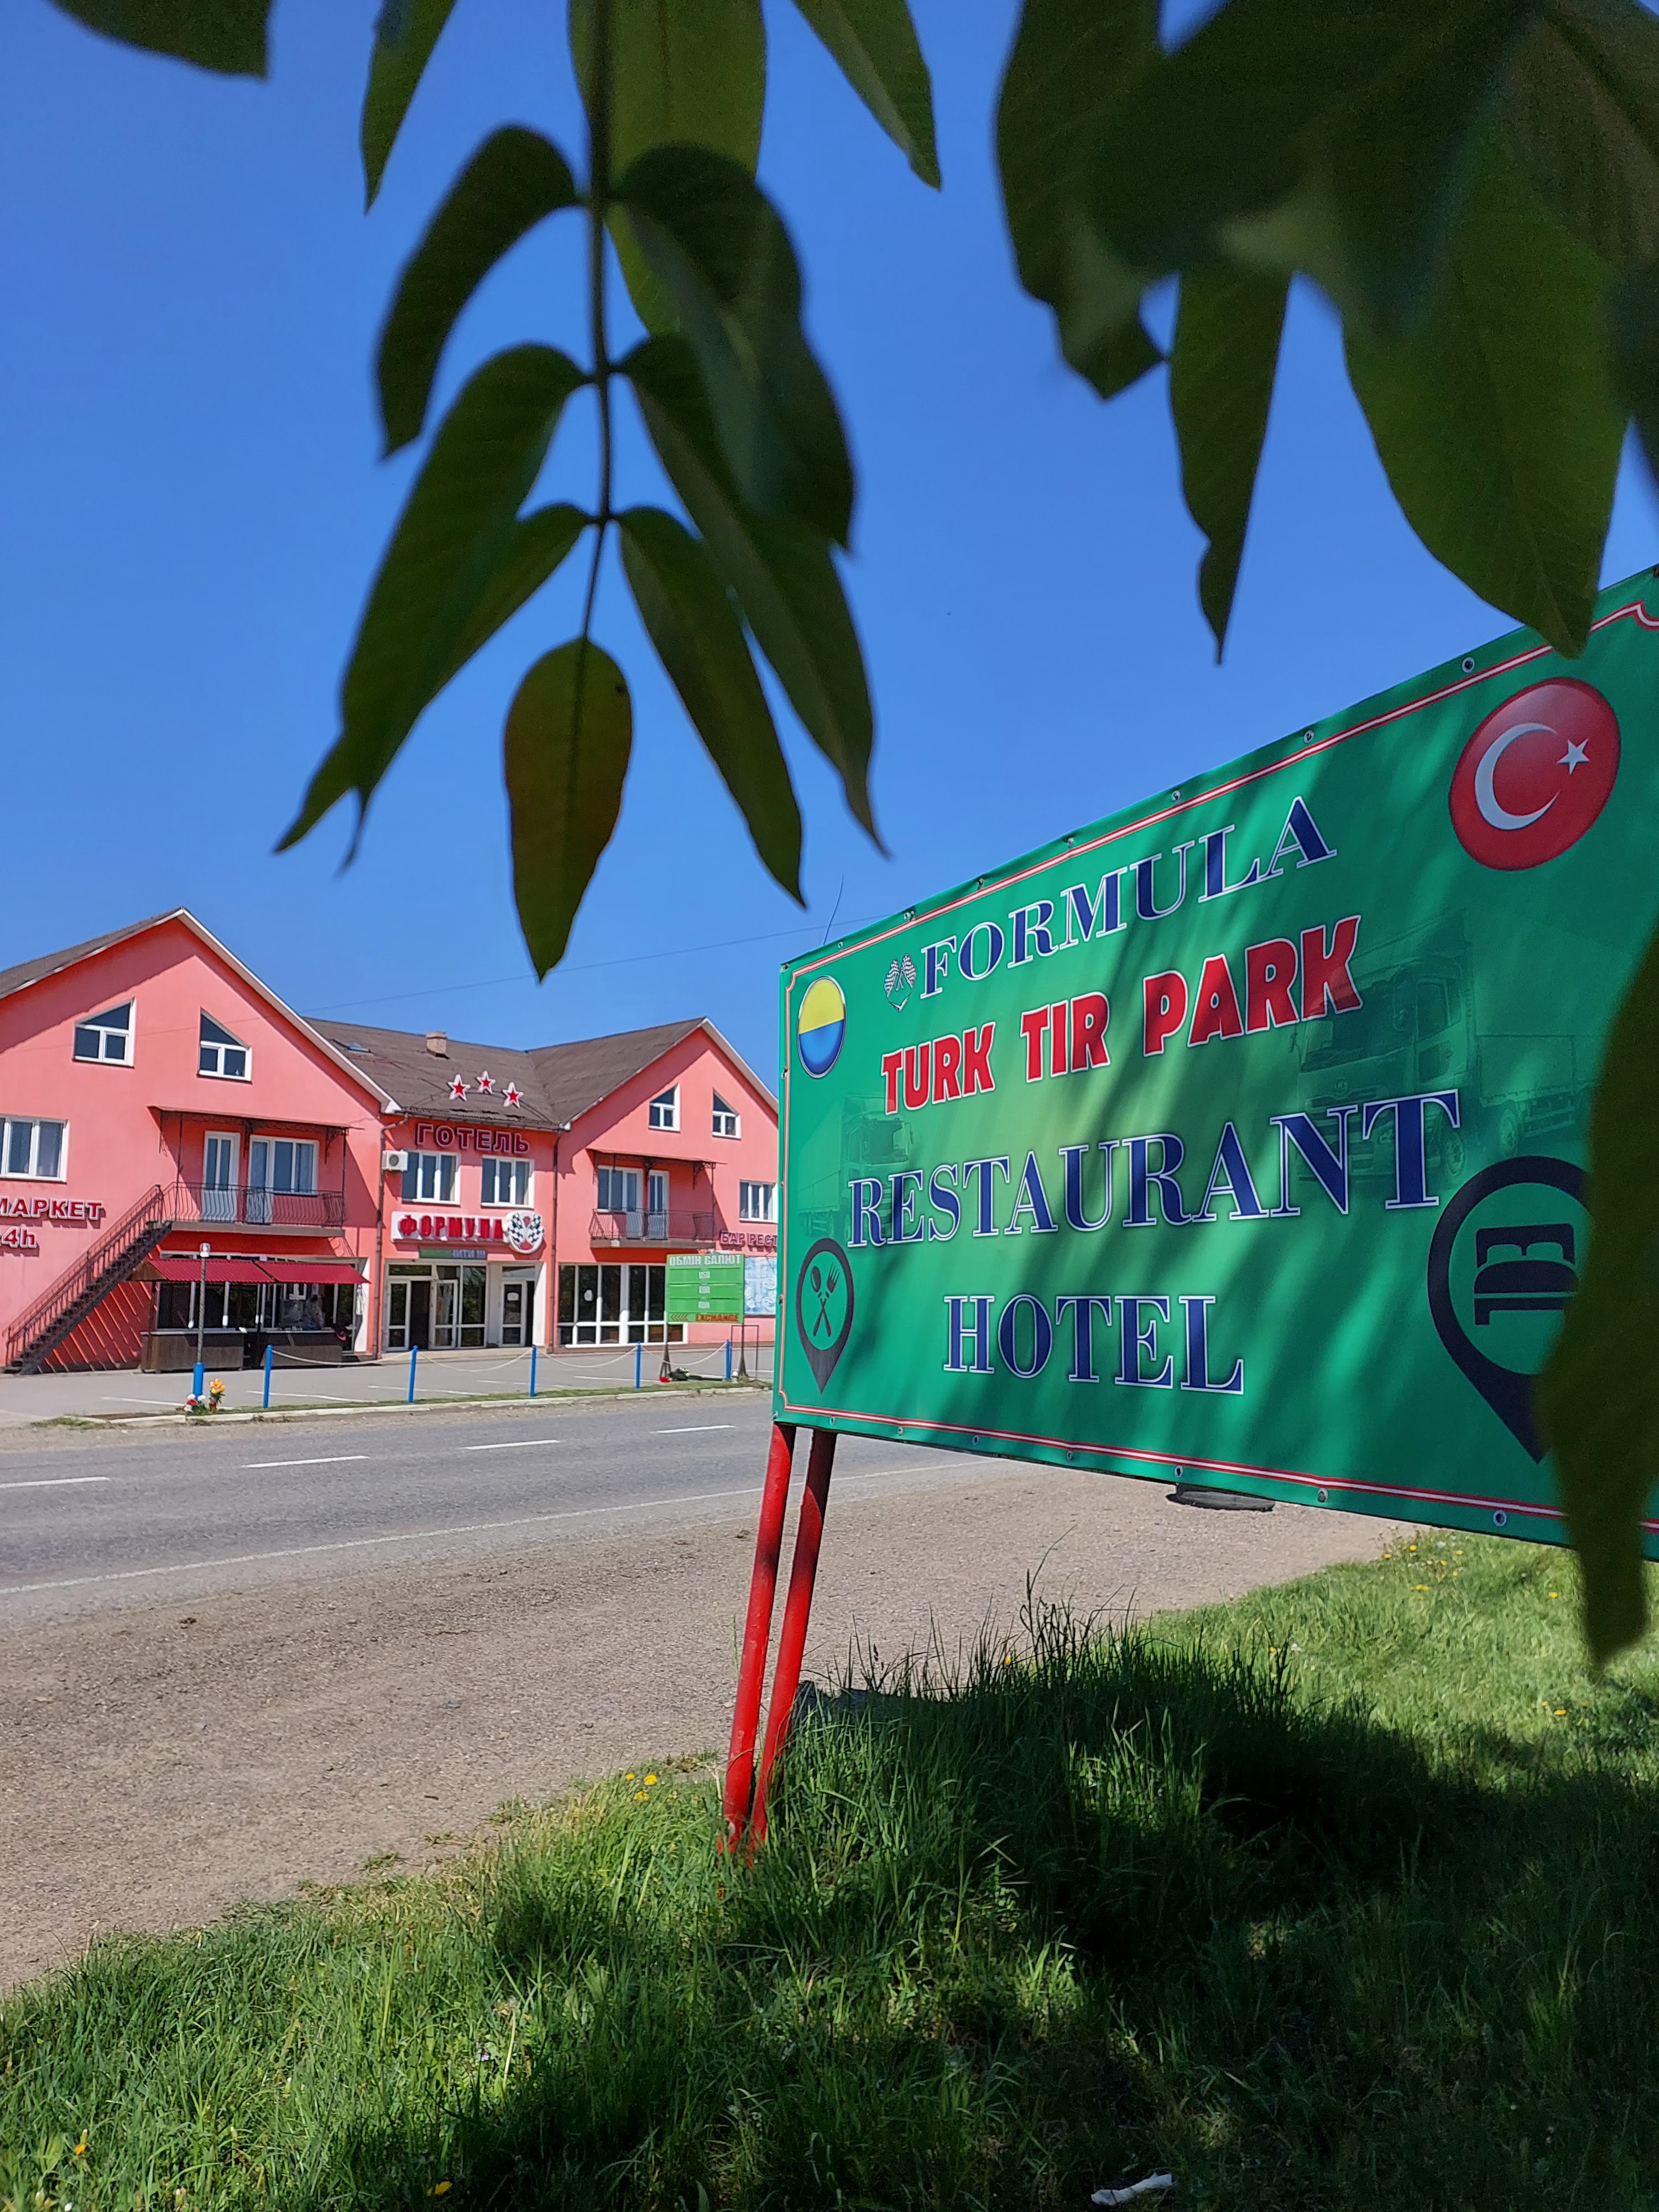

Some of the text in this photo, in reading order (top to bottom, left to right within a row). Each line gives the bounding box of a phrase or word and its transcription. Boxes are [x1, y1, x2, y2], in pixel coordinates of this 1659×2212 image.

[920, 796, 1337, 999] FORMULA
[881, 915, 1363, 1115] TURK TIR PARK
[416, 1123, 529, 1153] ГОТЕЛЬ
[848, 1089, 1460, 1248] RESTAURANT
[0, 1226, 37, 1248] 4h
[399, 1214, 504, 1239] ФОРМУЛА
[721, 1230, 745, 1244] БАР
[670, 1255, 741, 1265] ОБМІН ВАЛЮТ
[943, 1294, 1244, 1395] HOTEL
